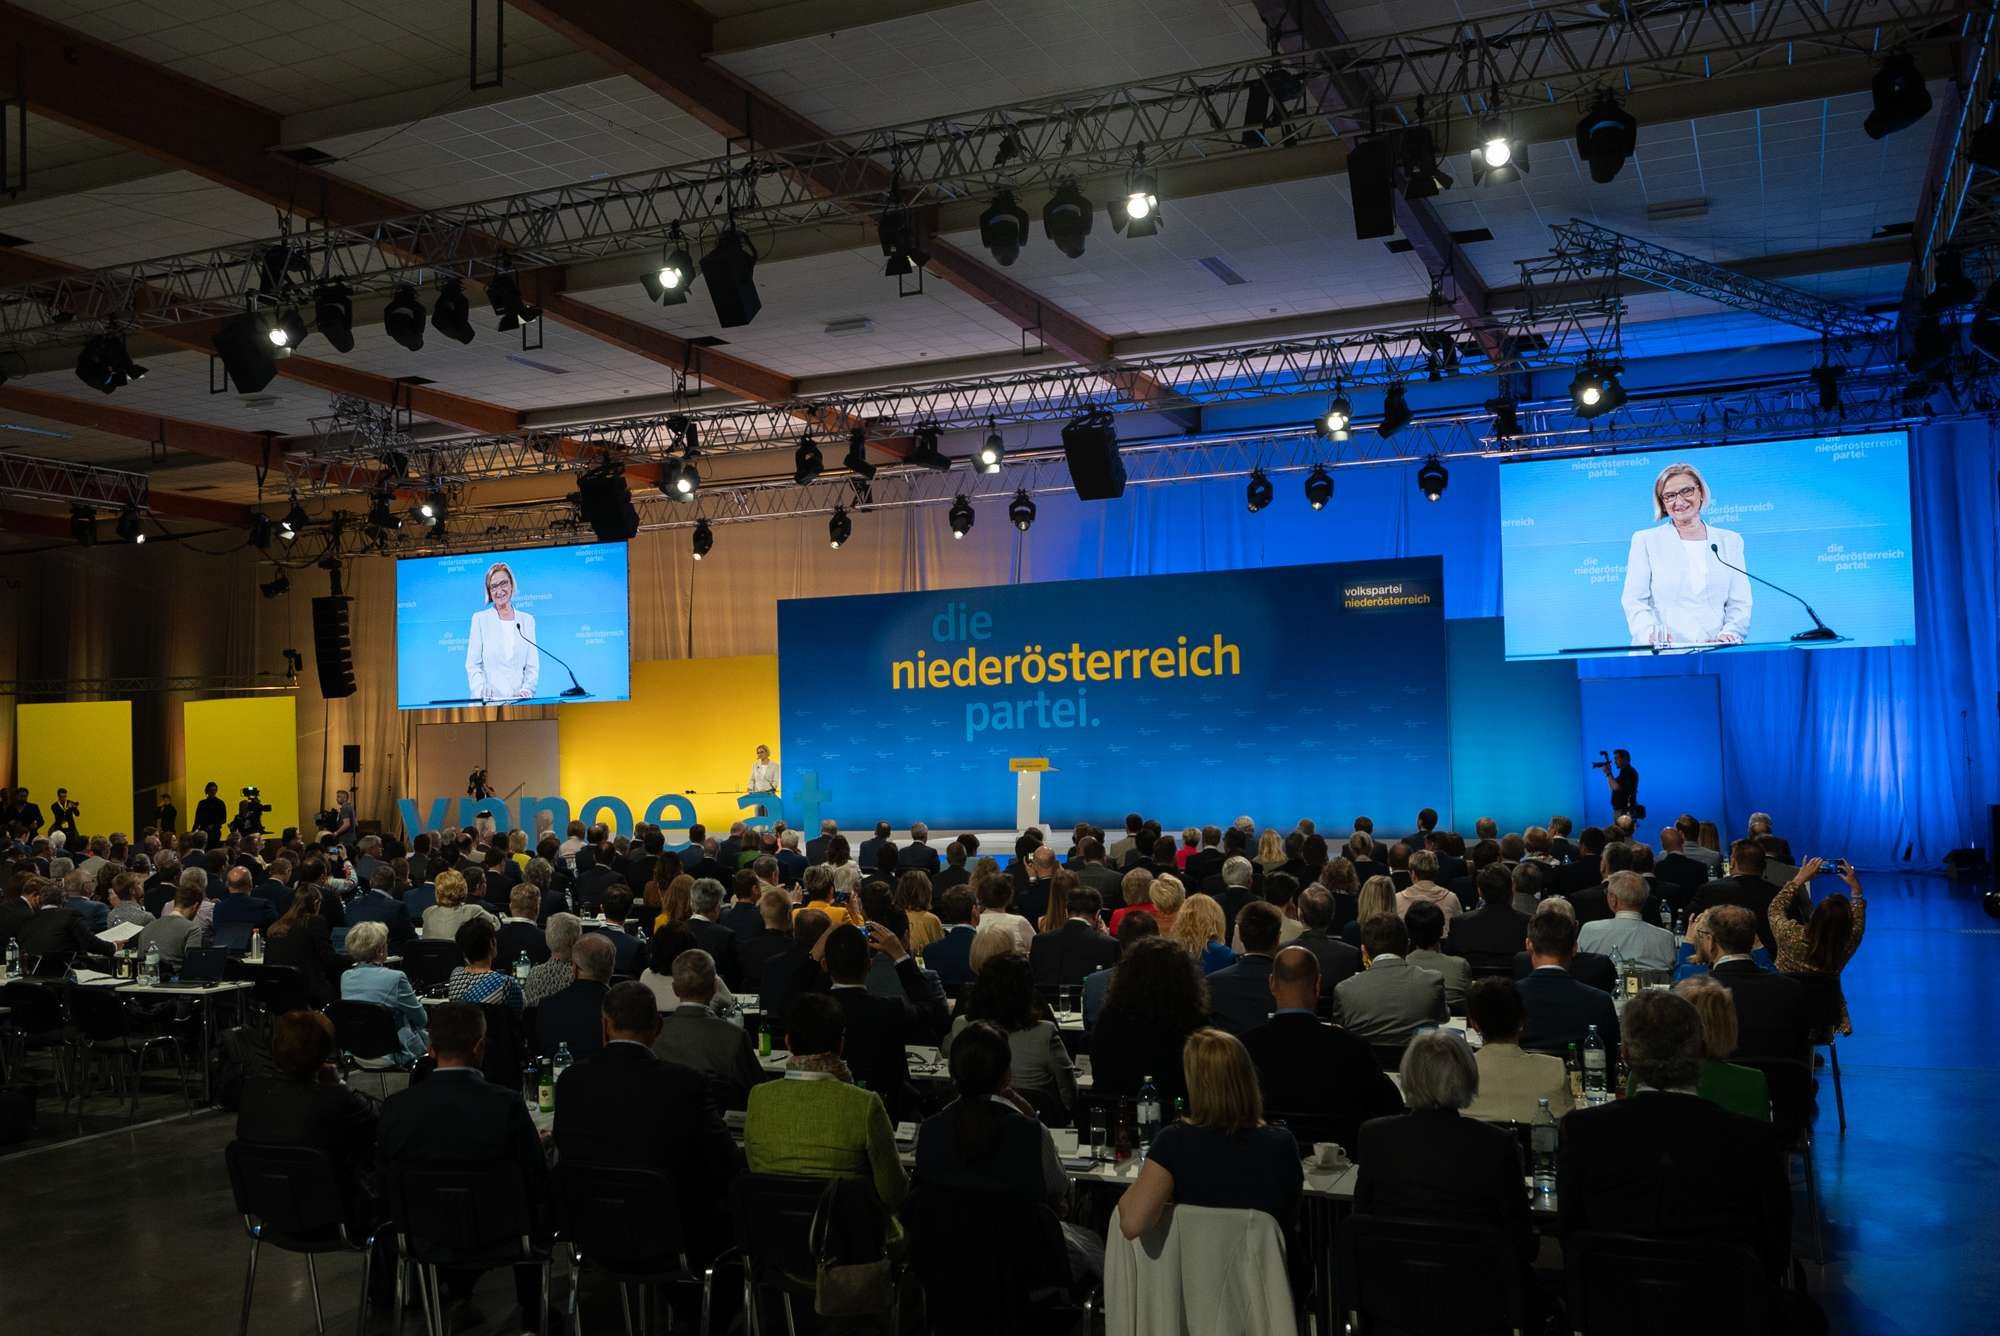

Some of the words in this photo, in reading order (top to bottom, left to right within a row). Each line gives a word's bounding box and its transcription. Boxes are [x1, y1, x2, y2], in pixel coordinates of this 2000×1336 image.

[1827, 544, 1844, 553] die
[1344, 584, 1402, 597] volkspartei
[1344, 594, 1430, 608] niederösterreich
[931, 600, 993, 642] die
[892, 634, 1240, 689] niederösterreich
[965, 687, 1100, 742] partei.
